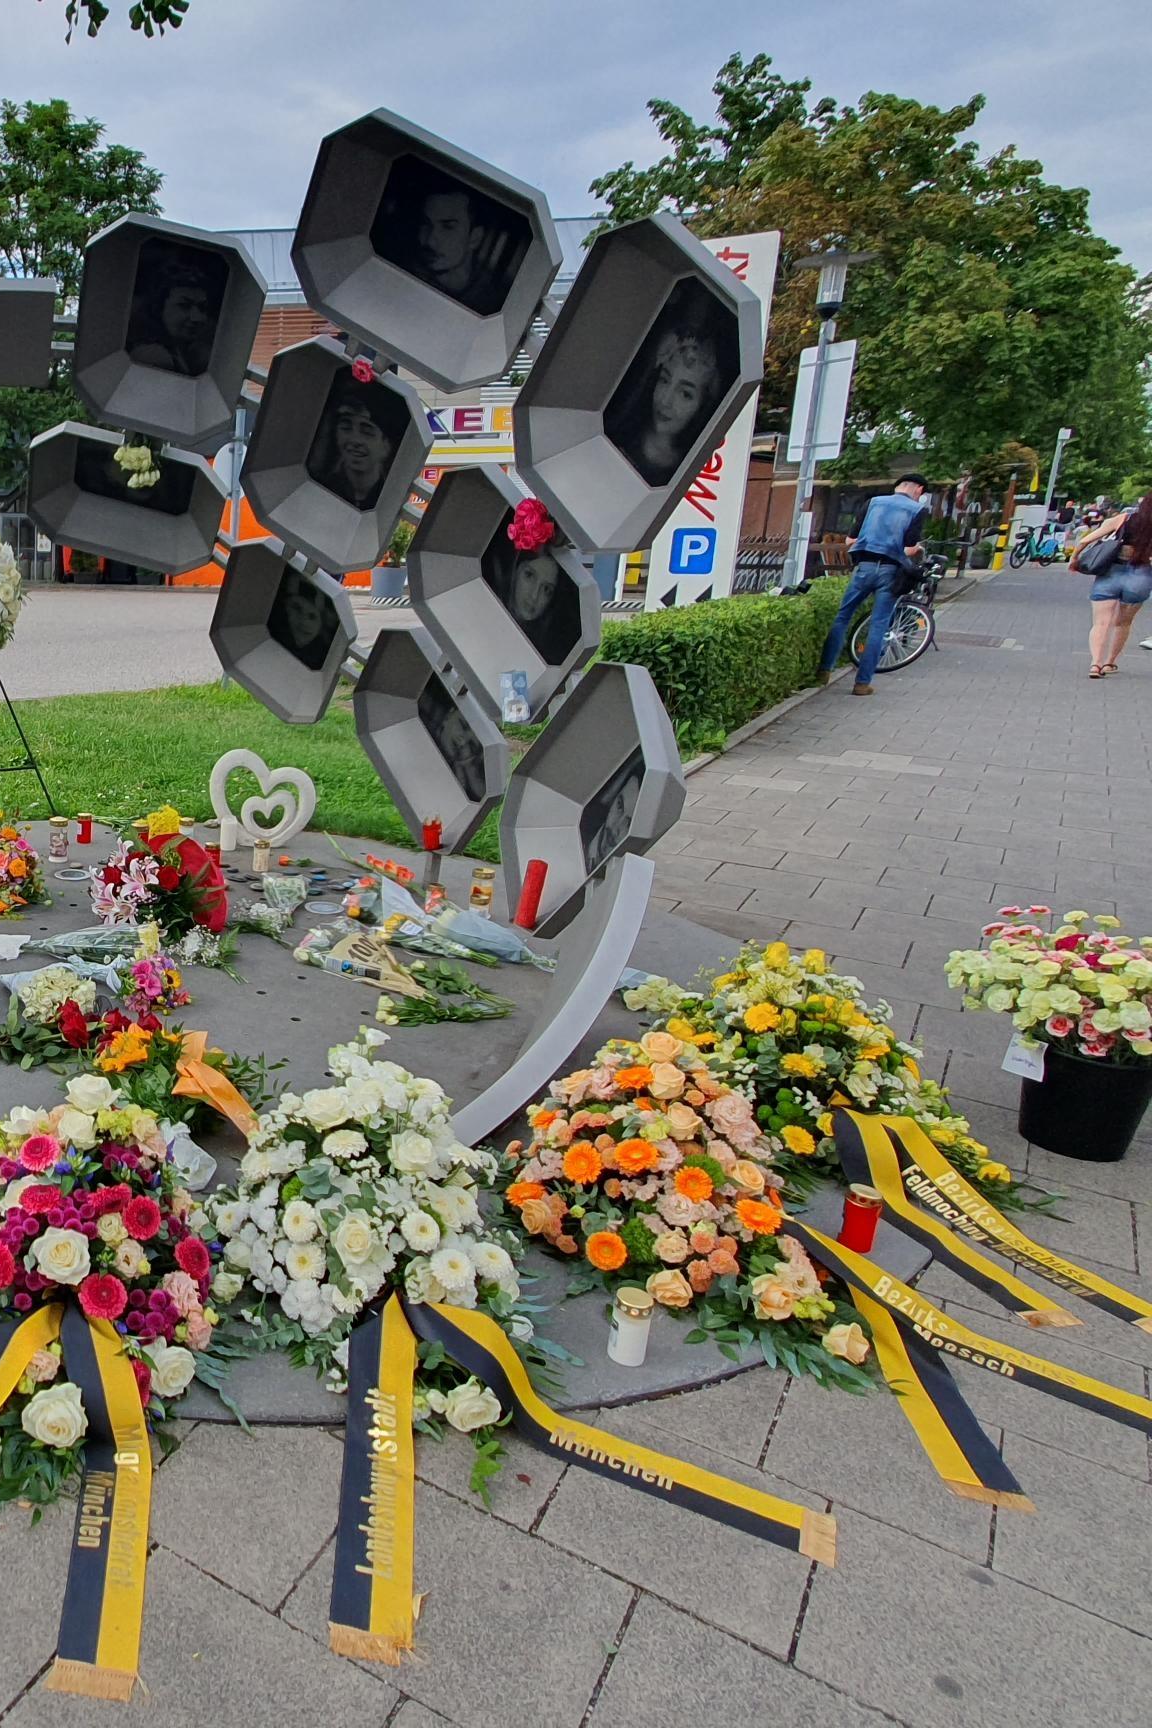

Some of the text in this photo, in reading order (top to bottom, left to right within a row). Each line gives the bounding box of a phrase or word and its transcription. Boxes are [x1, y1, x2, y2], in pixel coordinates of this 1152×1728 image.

[680, 535, 709, 567] P
[934, 1170, 1091, 1283] Bezirksausschuss
[912, 1322, 1018, 1377] Moosach
[355, 1387, 399, 1580] Landeshauptstadt
[549, 1426, 676, 1491] München
[78, 1470, 115, 1548] München
